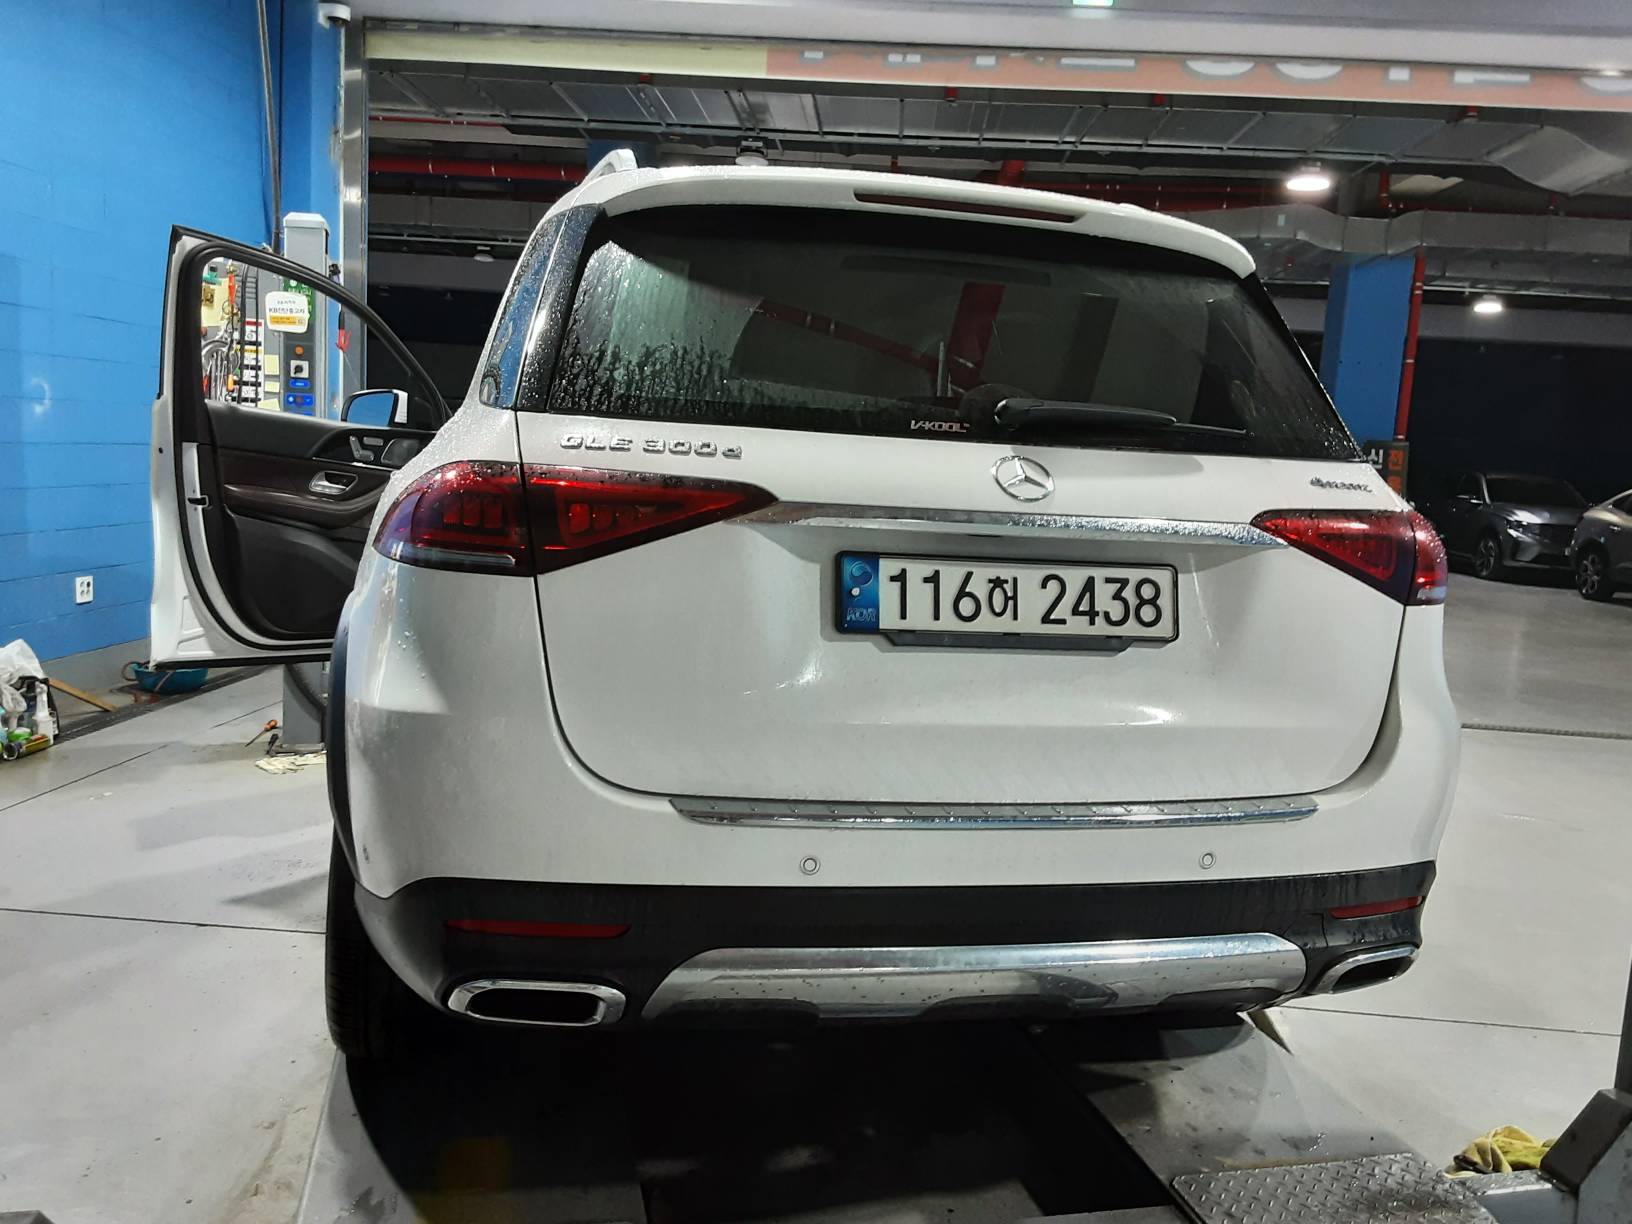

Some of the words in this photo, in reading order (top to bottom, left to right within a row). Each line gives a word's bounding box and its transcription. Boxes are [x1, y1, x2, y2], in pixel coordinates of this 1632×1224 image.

[560, 433, 633, 452] GLE
[889, 568, 1019, 623] 116허
[1040, 573, 1163, 628] 2438
[846, 610, 876, 622] KOR
